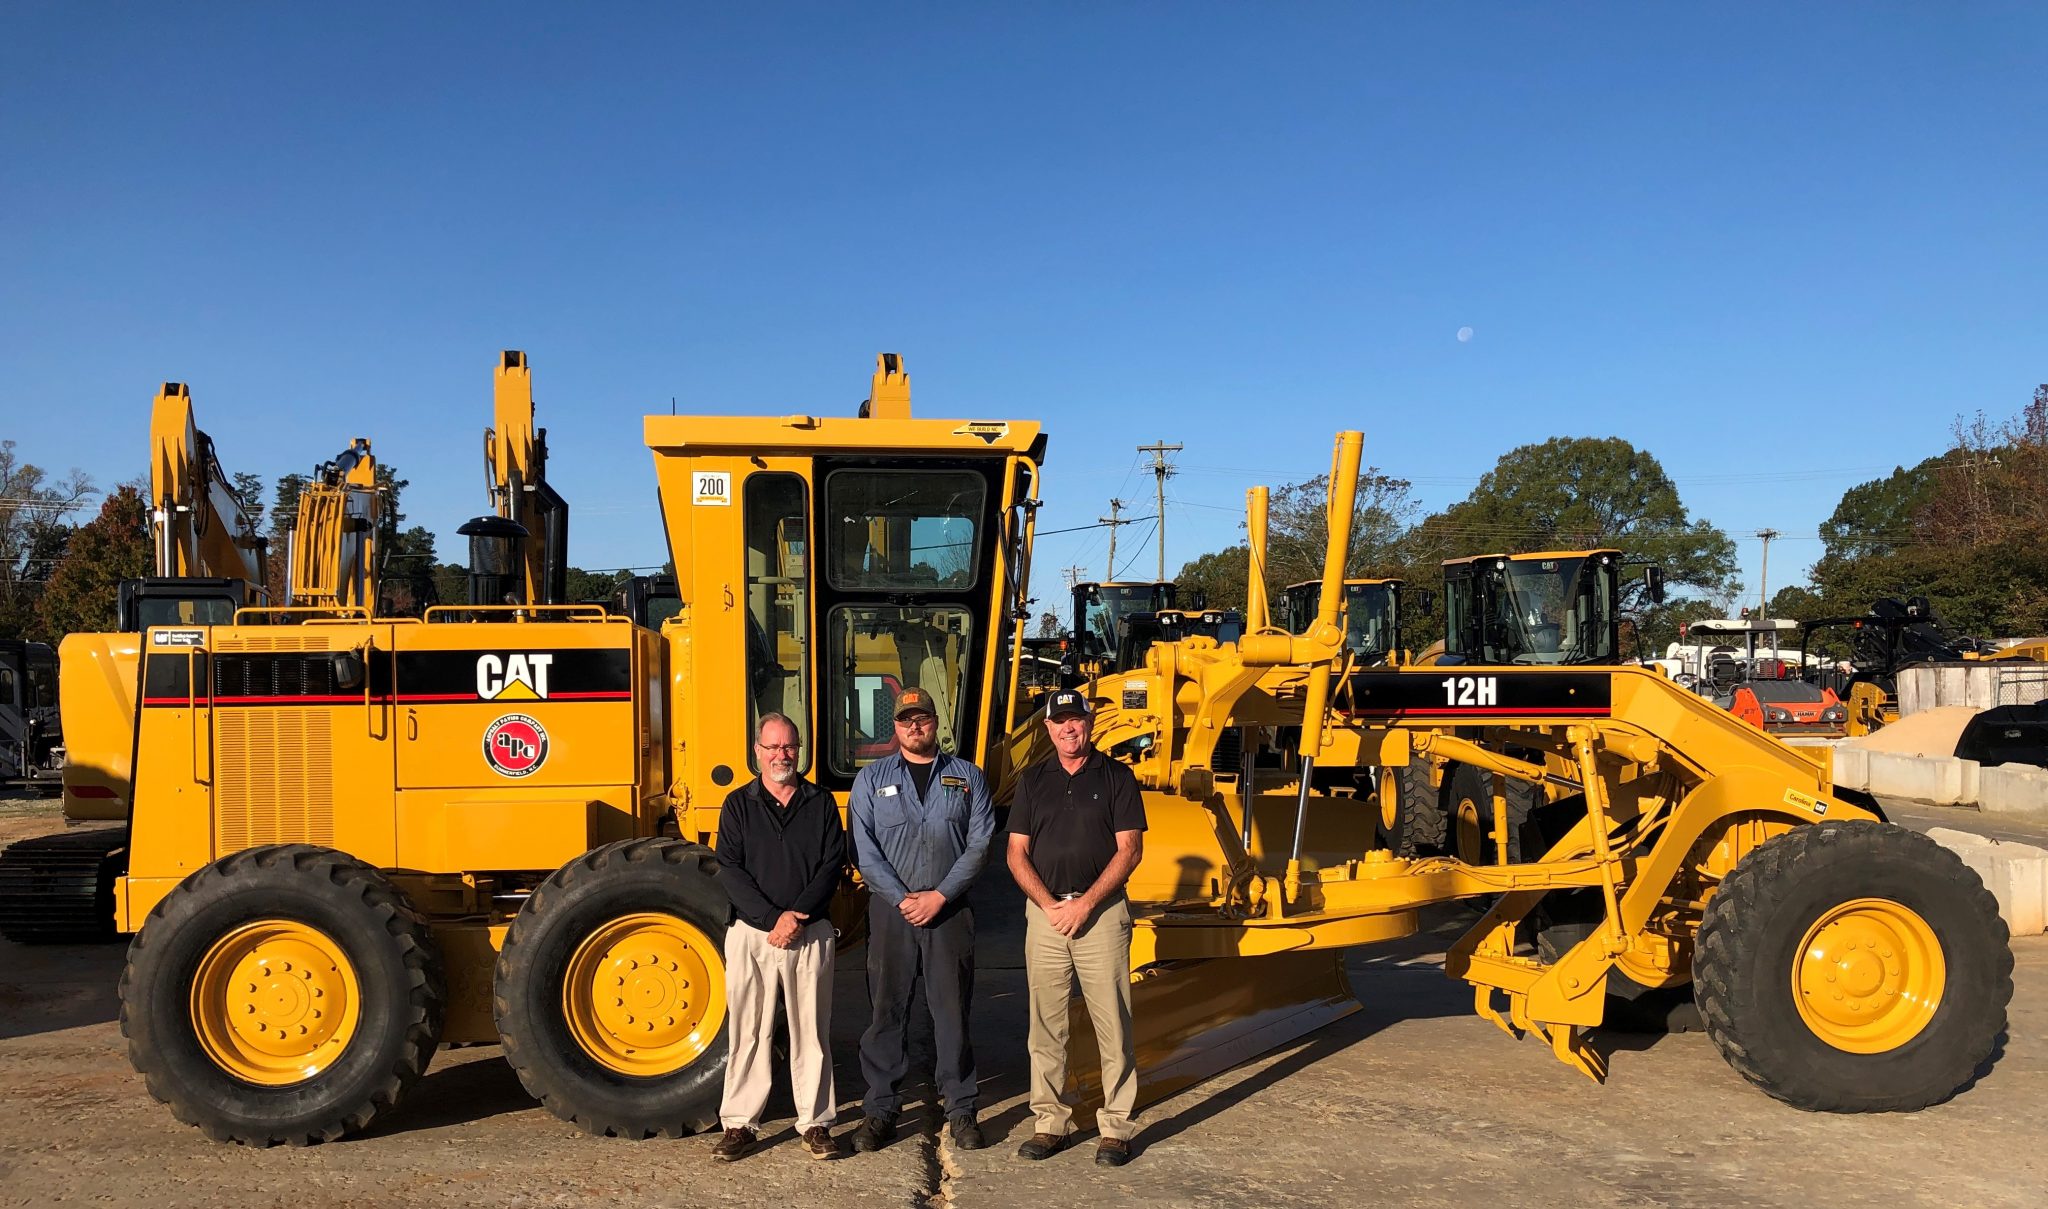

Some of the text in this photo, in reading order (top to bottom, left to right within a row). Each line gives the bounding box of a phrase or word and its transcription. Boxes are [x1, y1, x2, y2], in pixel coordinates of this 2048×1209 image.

[700, 478, 724, 496] 200
[1542, 561, 1554, 570] CAT
[476, 654, 553, 700] CAT
[903, 693, 919, 704] CAT
[1057, 694, 1073, 705] CAT
[1442, 677, 1496, 706] 12H
[1789, 793, 1826, 813] Carolina CAT
